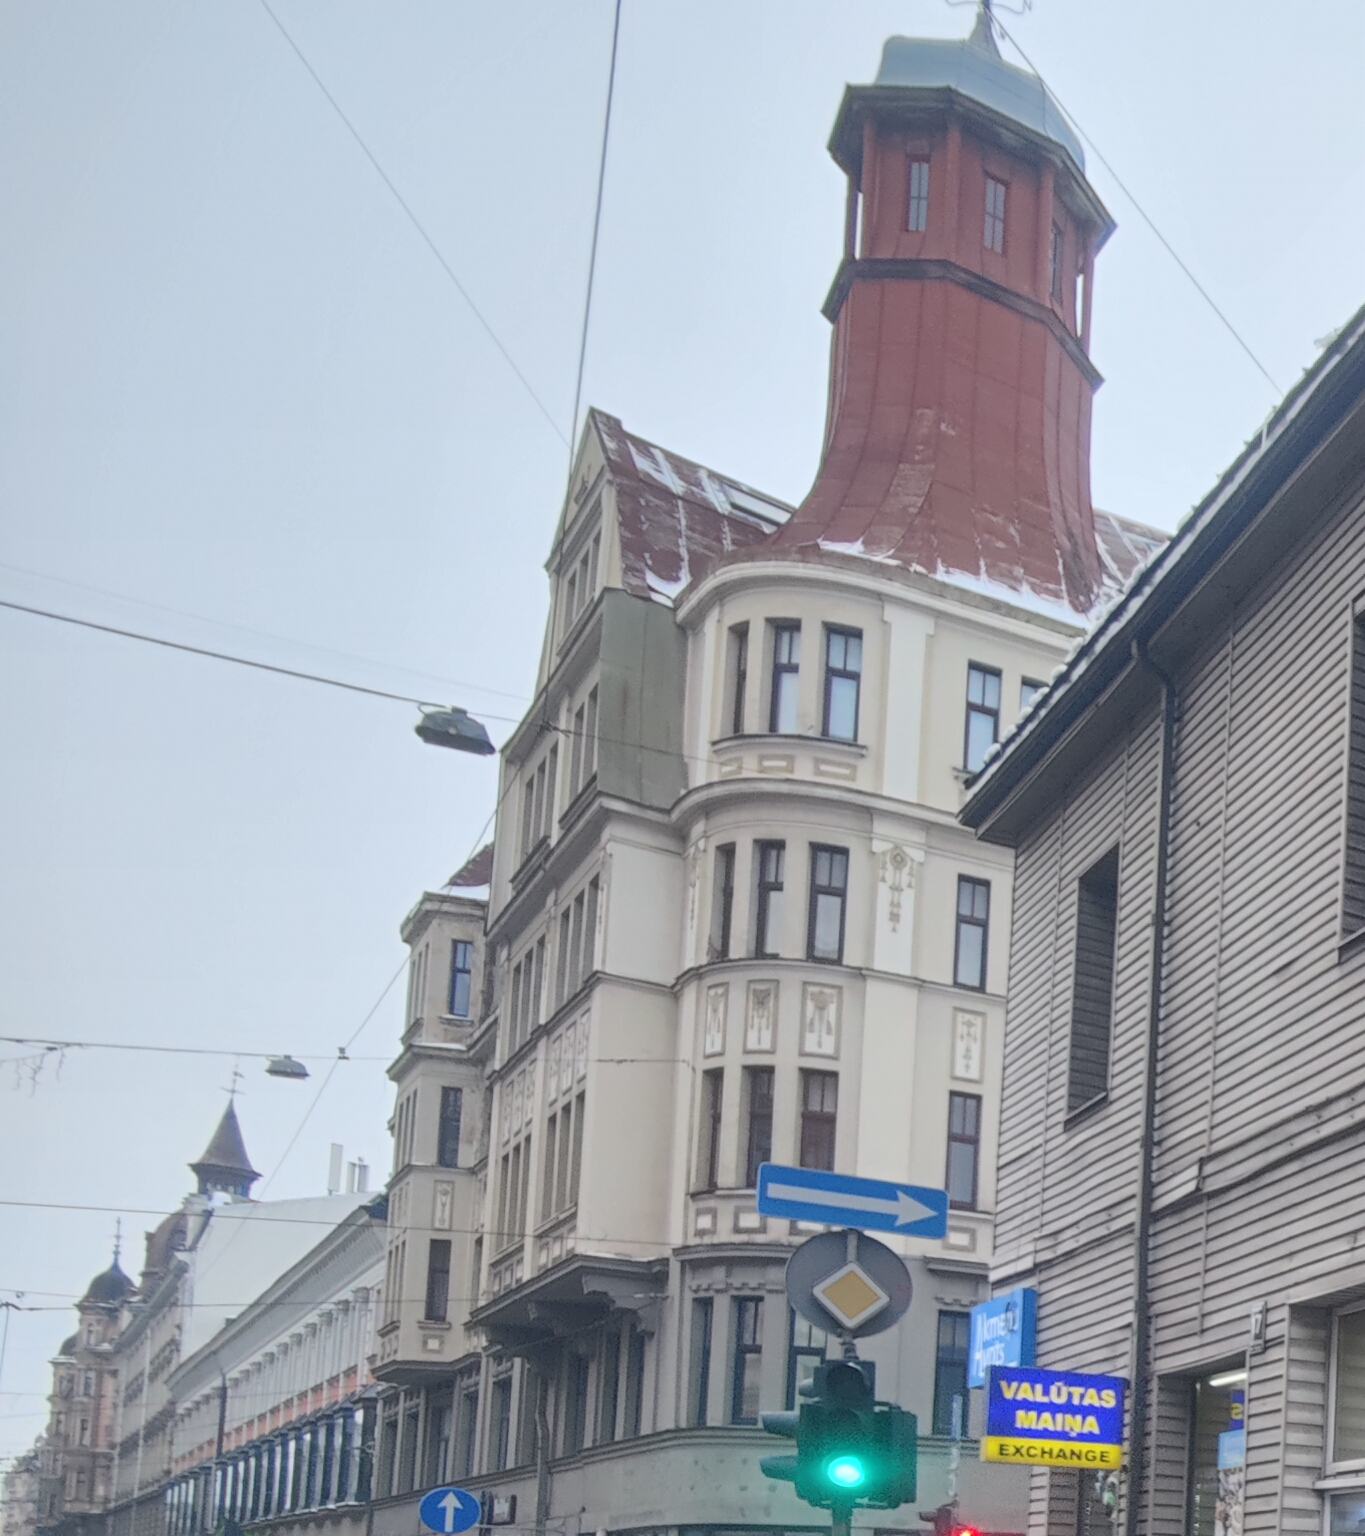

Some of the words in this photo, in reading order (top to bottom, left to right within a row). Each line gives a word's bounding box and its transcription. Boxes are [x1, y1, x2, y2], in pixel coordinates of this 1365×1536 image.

[998, 1381, 1117, 1409] VALŪTAS
[1014, 1409, 1100, 1437] MAIŅA
[997, 1443, 1111, 1463] EXCHANGE
